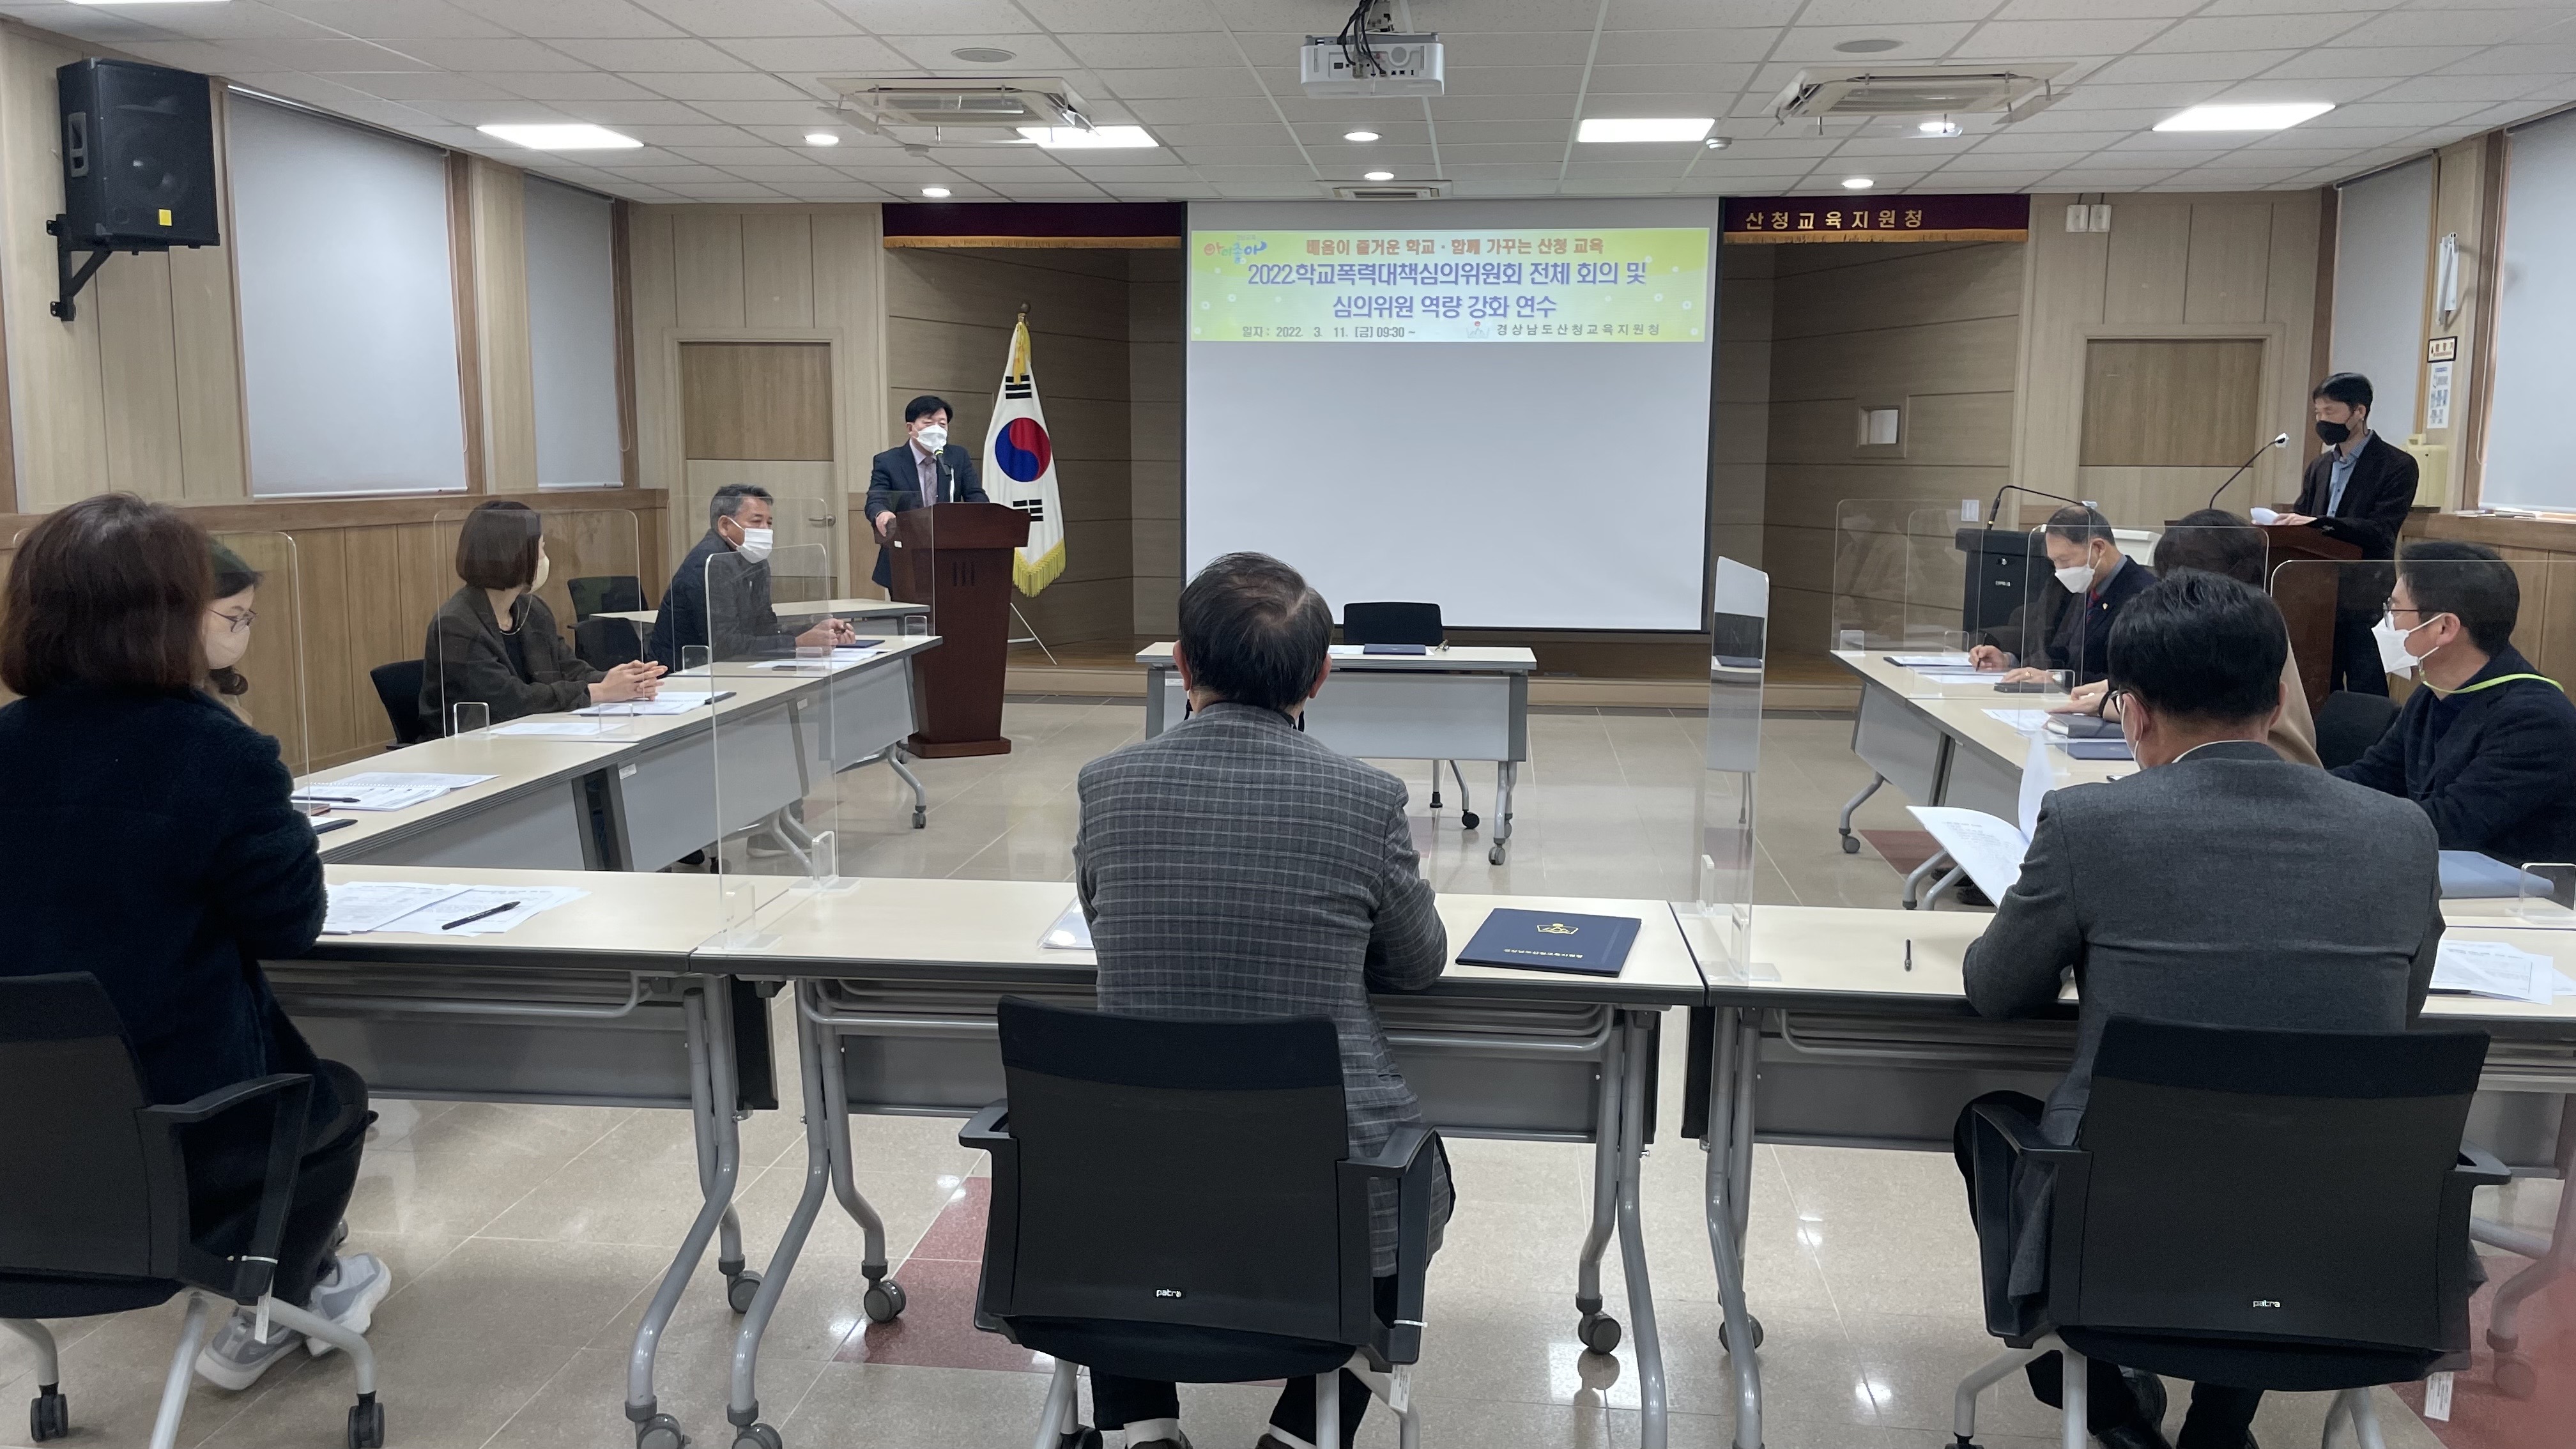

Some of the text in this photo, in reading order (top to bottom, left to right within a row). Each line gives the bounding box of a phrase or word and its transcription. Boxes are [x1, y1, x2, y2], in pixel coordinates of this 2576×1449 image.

[1745, 210, 1922, 230] 산청교육지원청
[1306, 239, 1350, 256] 배움이
[1356, 240, 1400, 256] 즐거운
[1406, 239, 1435, 256] 학교
[1451, 238, 1480, 255] 함께
[1487, 238, 1531, 254] 가꾸는
[1537, 238, 1567, 254] 산청
[1574, 238, 1604, 254] 교육
[1529, 262, 1570, 285] 전체
[1577, 262, 1618, 285] 회의
[1626, 262, 1646, 285] 및
[1333, 295, 1557, 318] 심의위원 역량 강화 연수
[1497, 323, 1660, 336] 경상남도산청교육지원청
